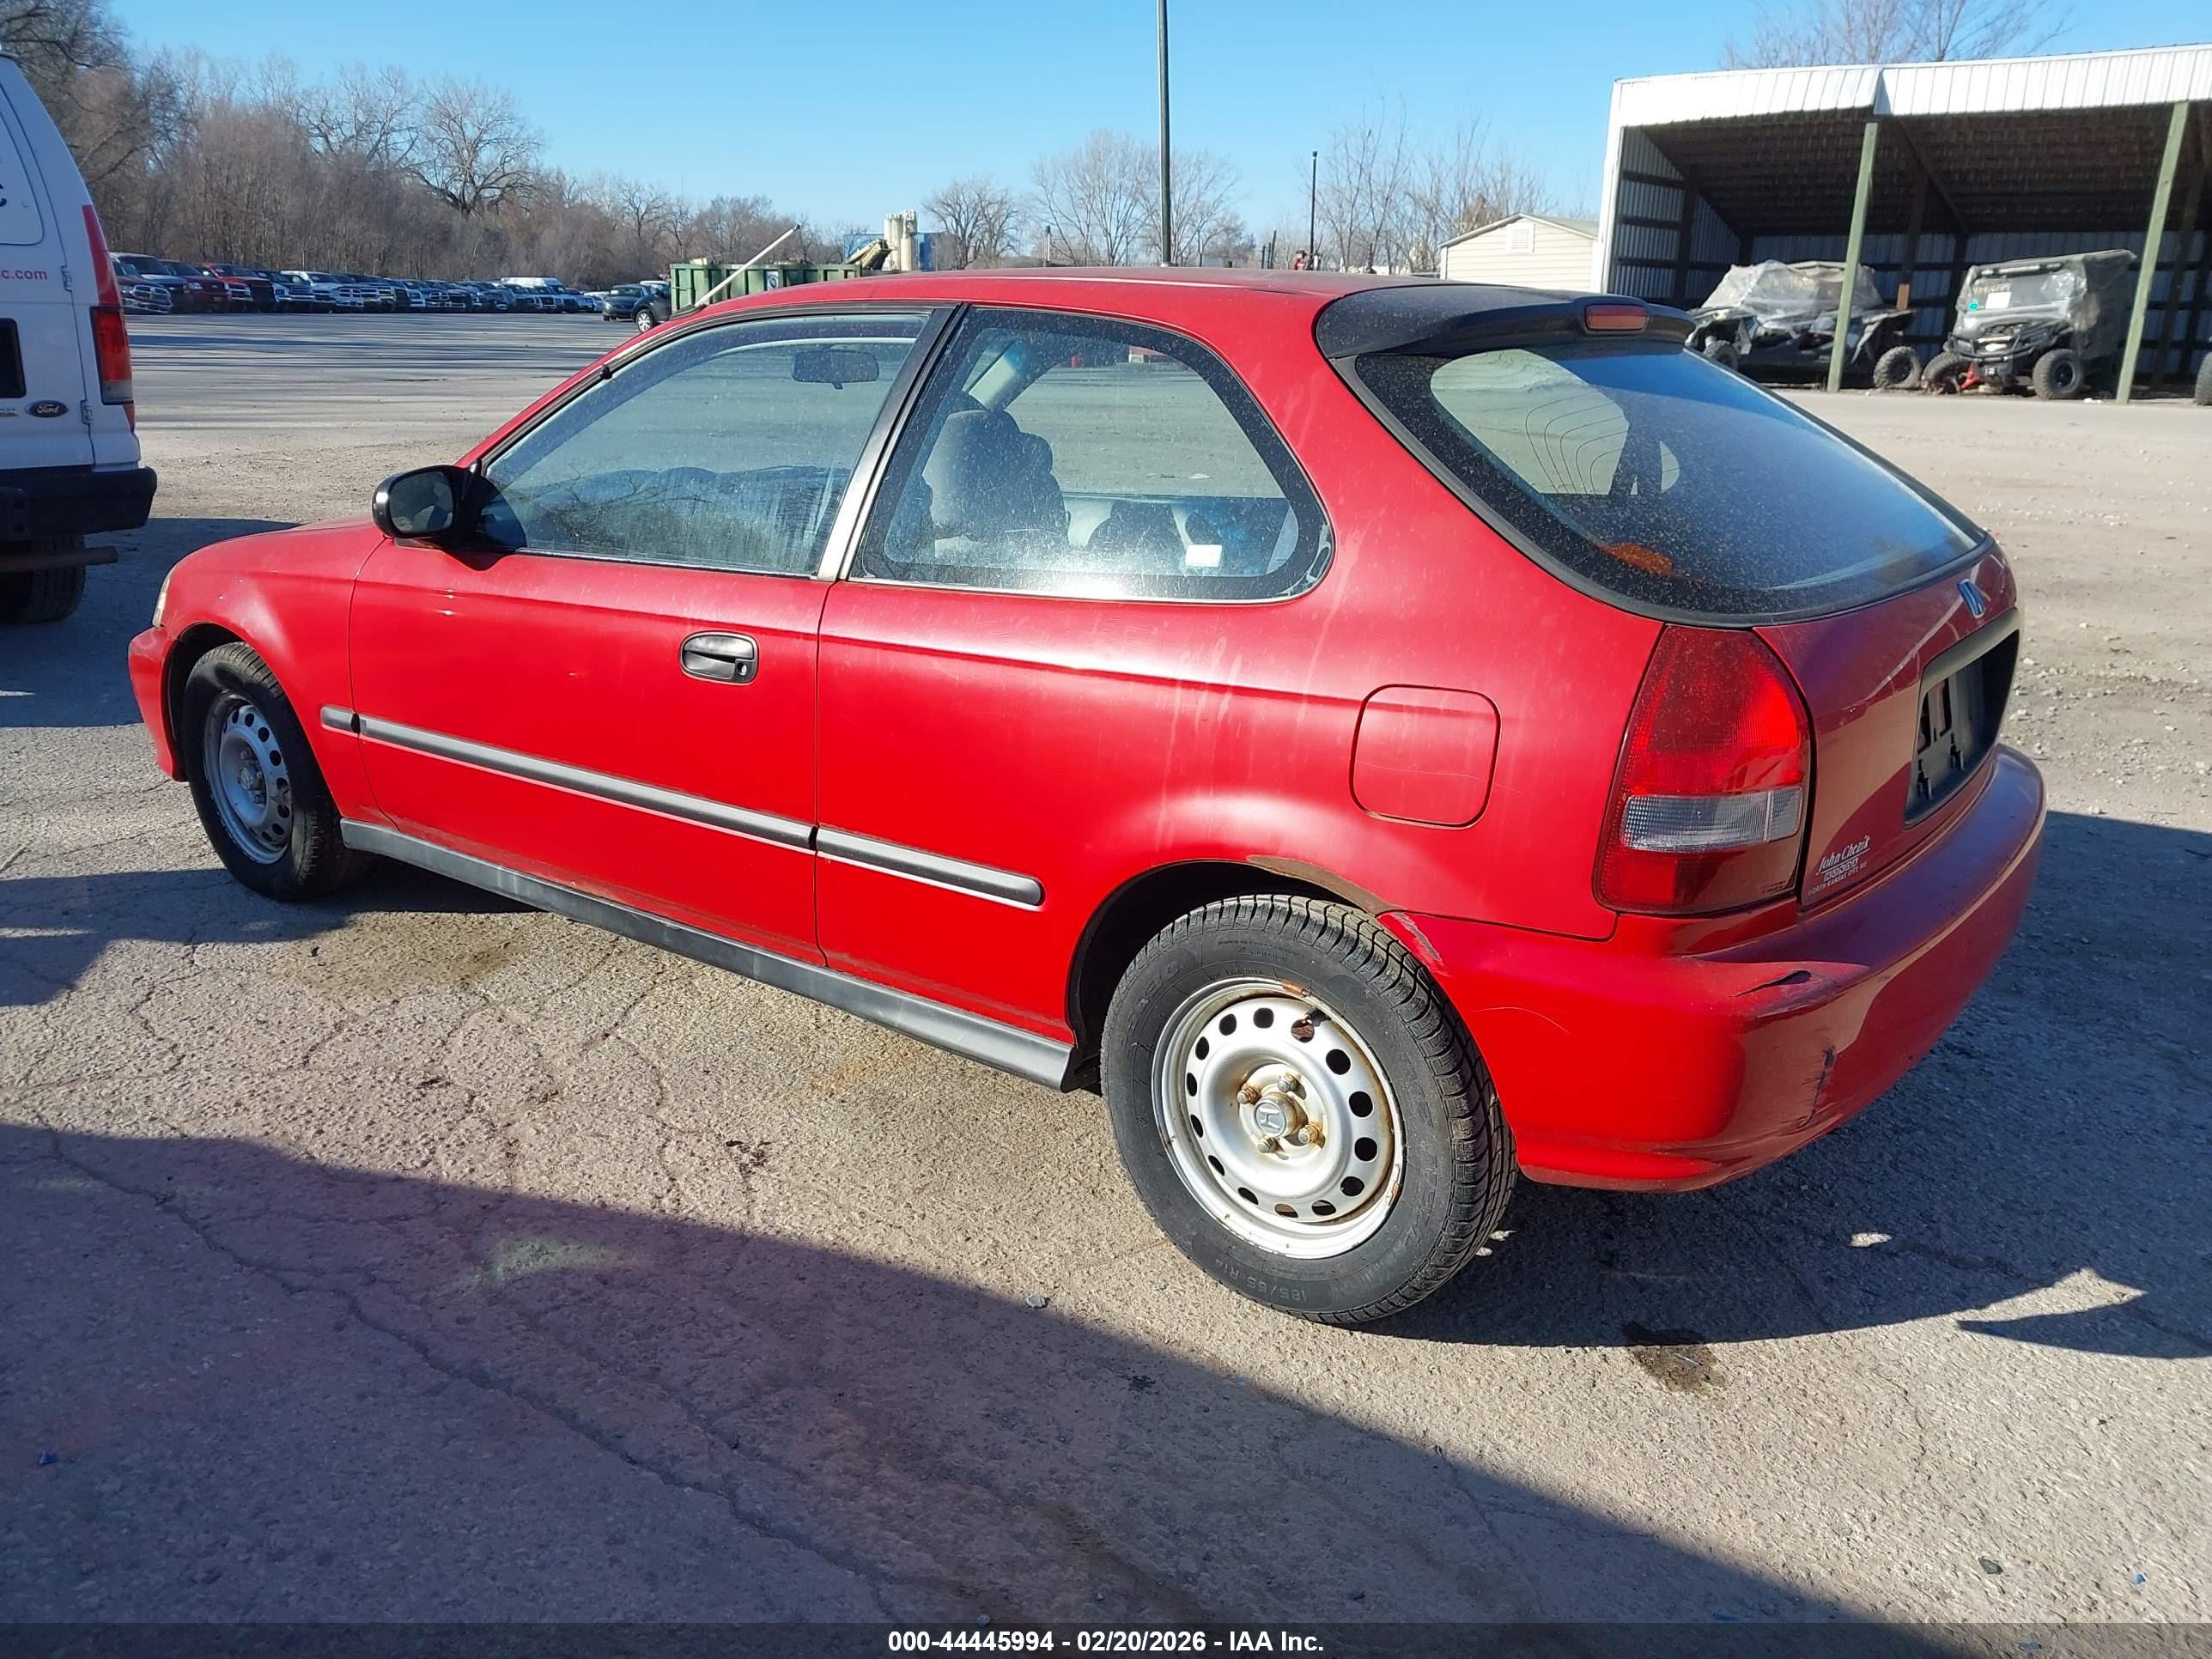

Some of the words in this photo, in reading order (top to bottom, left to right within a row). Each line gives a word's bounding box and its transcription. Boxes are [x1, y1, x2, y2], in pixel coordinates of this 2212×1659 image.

[1815, 852, 1841, 876] John
[1826, 872, 1847, 887] KANSAS
[1246, 1276, 1307, 1303] 185/65
